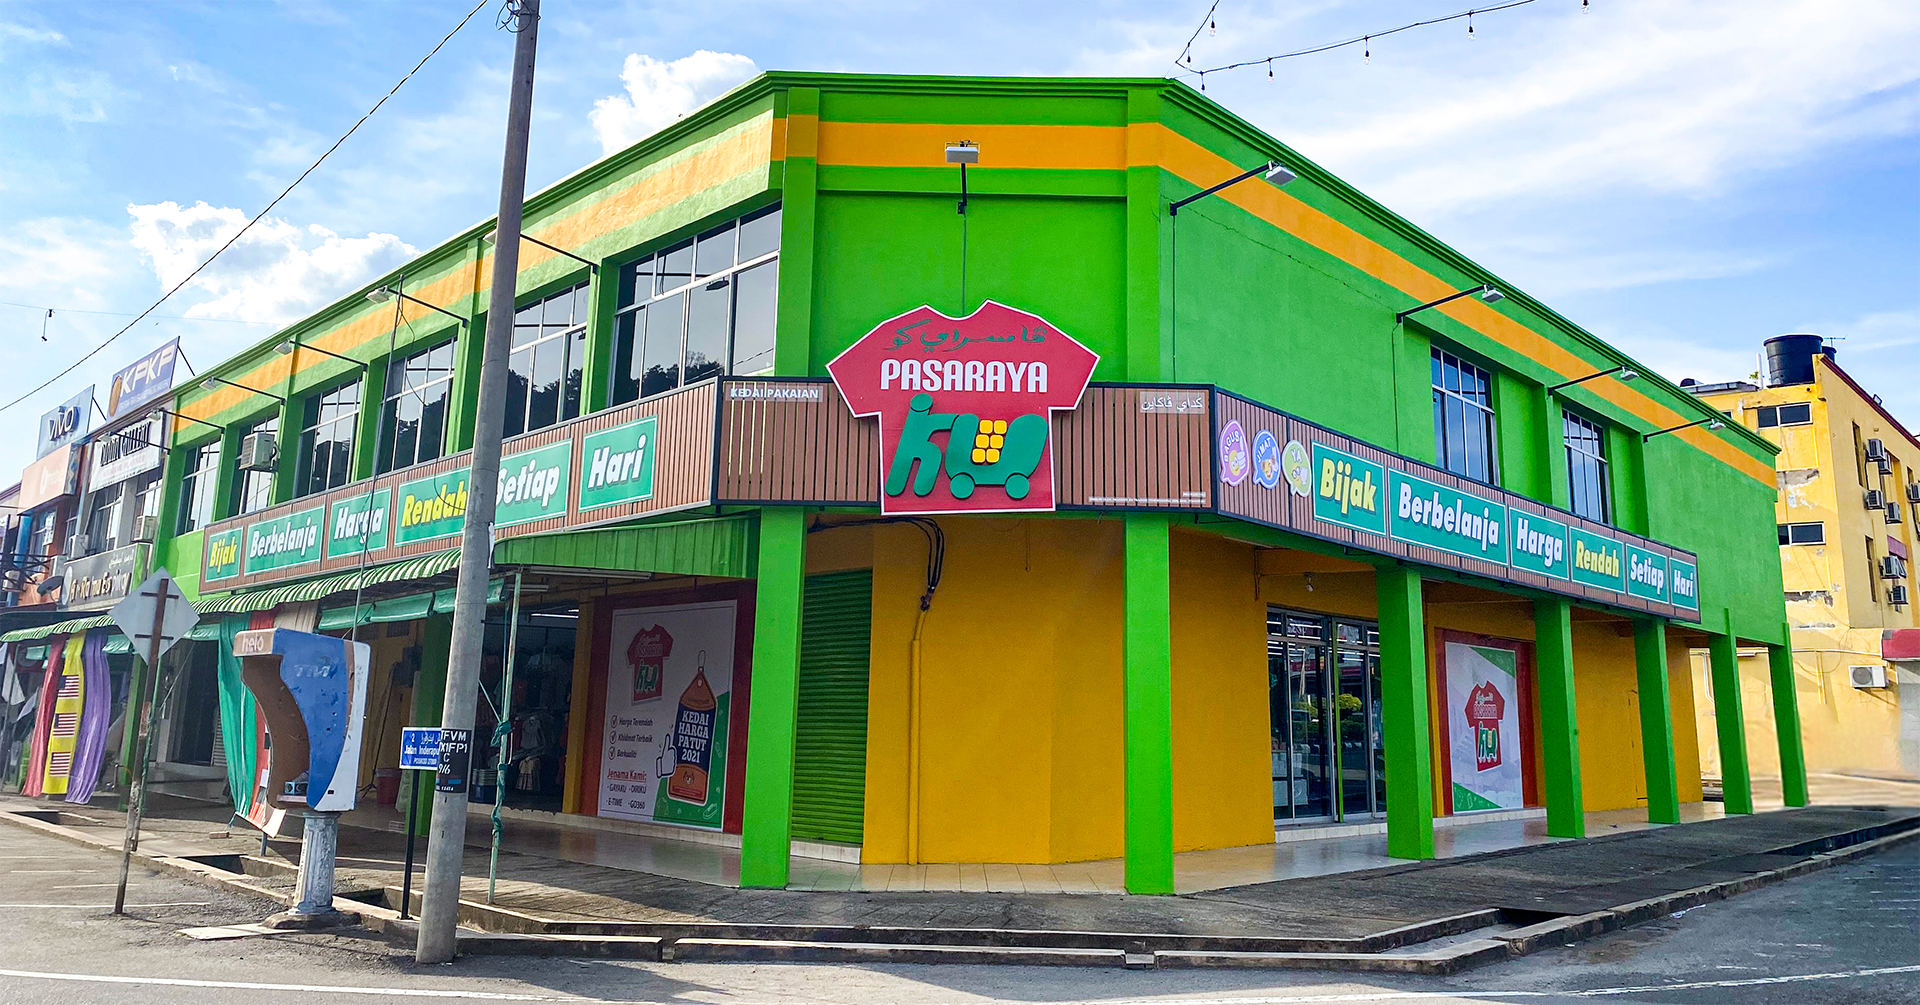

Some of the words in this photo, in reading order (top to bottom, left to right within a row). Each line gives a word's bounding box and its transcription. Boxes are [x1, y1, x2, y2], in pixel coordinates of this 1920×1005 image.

[120, 344, 175, 398] KPKP
[880, 358, 1048, 393] PASARAYA
[730, 388, 764, 398] KEDAI
[767, 388, 819, 399] PAKAIAN
[1223, 430, 1240, 463] BAGUS
[1256, 436, 1271, 463] JIMAT
[1290, 448, 1303, 463] YA
[208, 536, 238, 574] Bijak
[249, 517, 318, 558] Berbelanja
[334, 504, 386, 545] Harga
[400, 481, 468, 528] Rendah
[495, 458, 560, 509] Setiap
[587, 434, 647, 490] Hari
[1319, 457, 1378, 515] Bijak
[1398, 482, 1499, 551] Berbelanja
[1517, 517, 1563, 567] Harga
[1575, 540, 1620, 578] Rendah
[1630, 553, 1665, 595] Setiap
[1673, 568, 1694, 597] Hari
[241, 635, 264, 652] helo
[633, 718, 653, 726] Terendah
[681, 710, 709, 726] KEDAI
[411, 732, 416, 743] 2
[636, 734, 653, 743] Terbaik
[678, 722, 709, 739] HARGA
[404, 744, 418, 755] Jalan
[678, 735, 707, 752] PATUT
[443, 752, 451, 763] C
[681, 748, 700, 763] 2021
[607, 768, 629, 780] Jenama
[629, 769, 647, 781] Kami:
